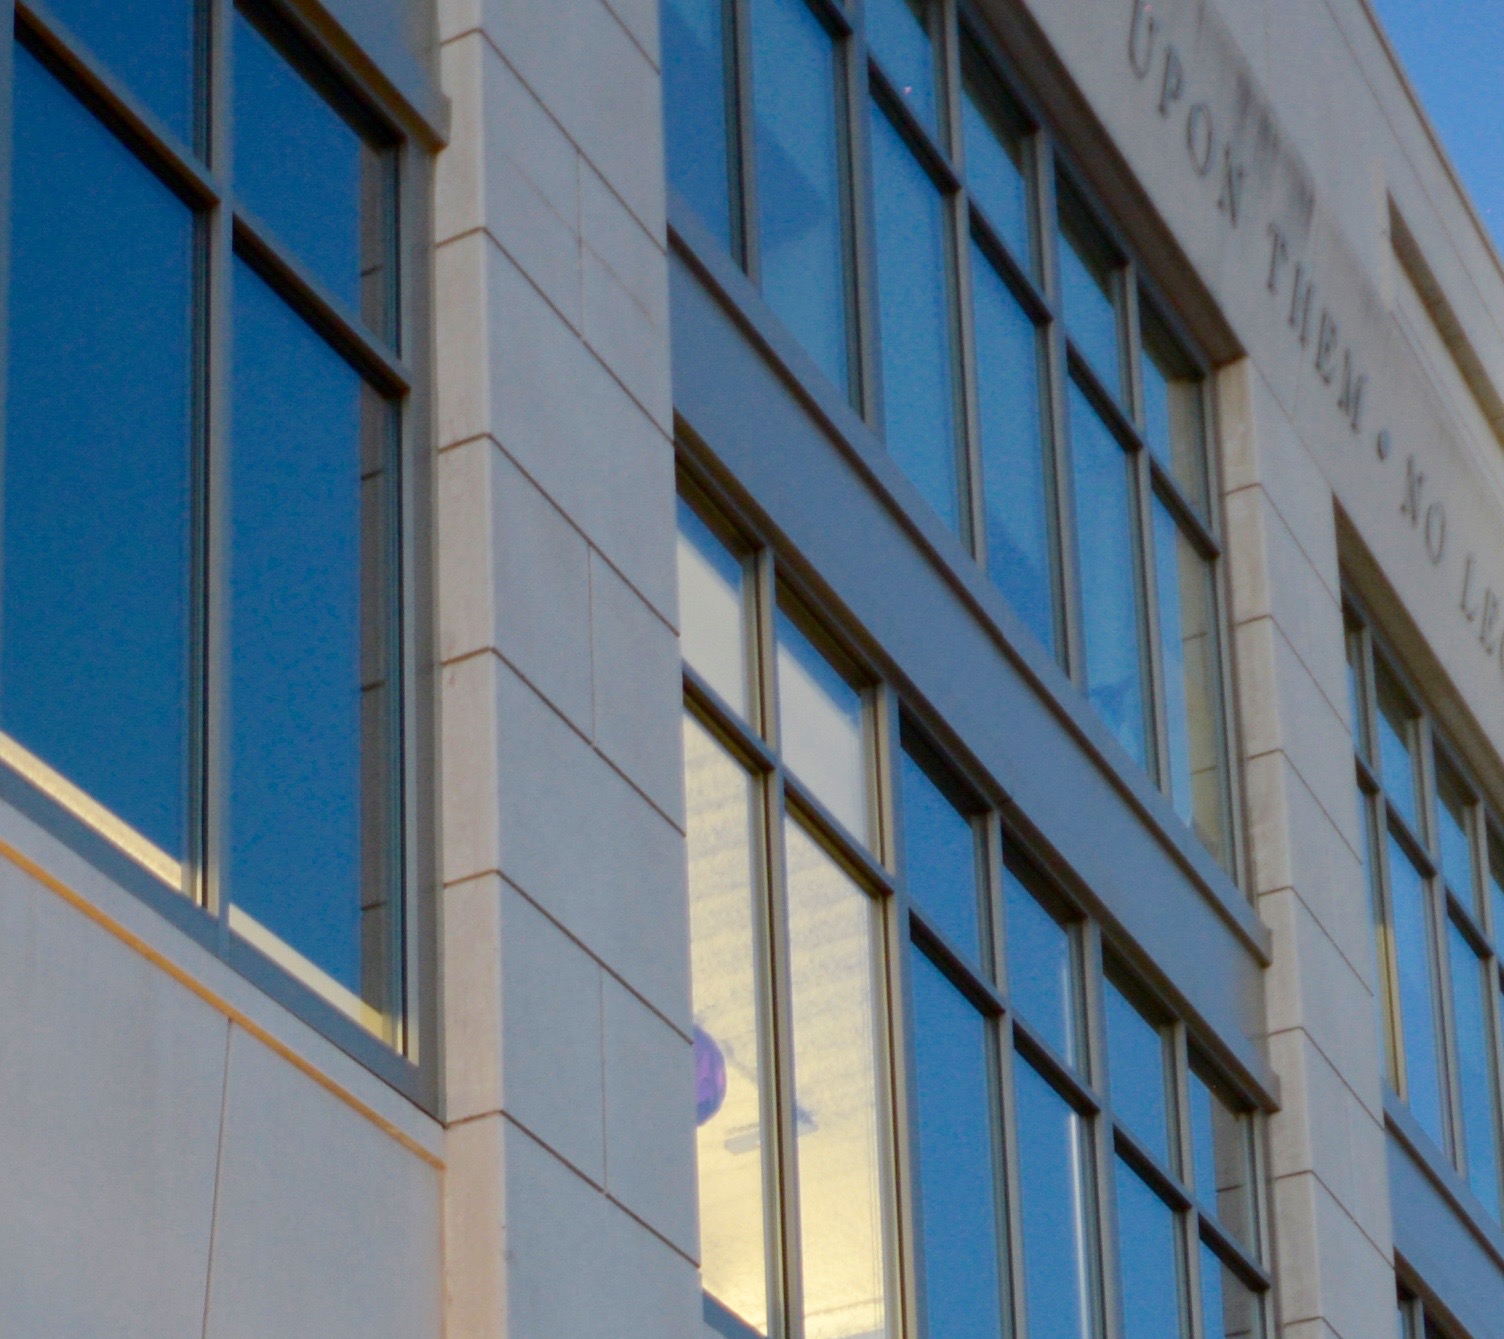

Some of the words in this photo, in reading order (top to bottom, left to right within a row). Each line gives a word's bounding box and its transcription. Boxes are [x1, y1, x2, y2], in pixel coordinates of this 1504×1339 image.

[1128, 0, 1245, 229] UPON
[1267, 222, 1369, 434] THEM
[1399, 453, 1446, 567] NO
